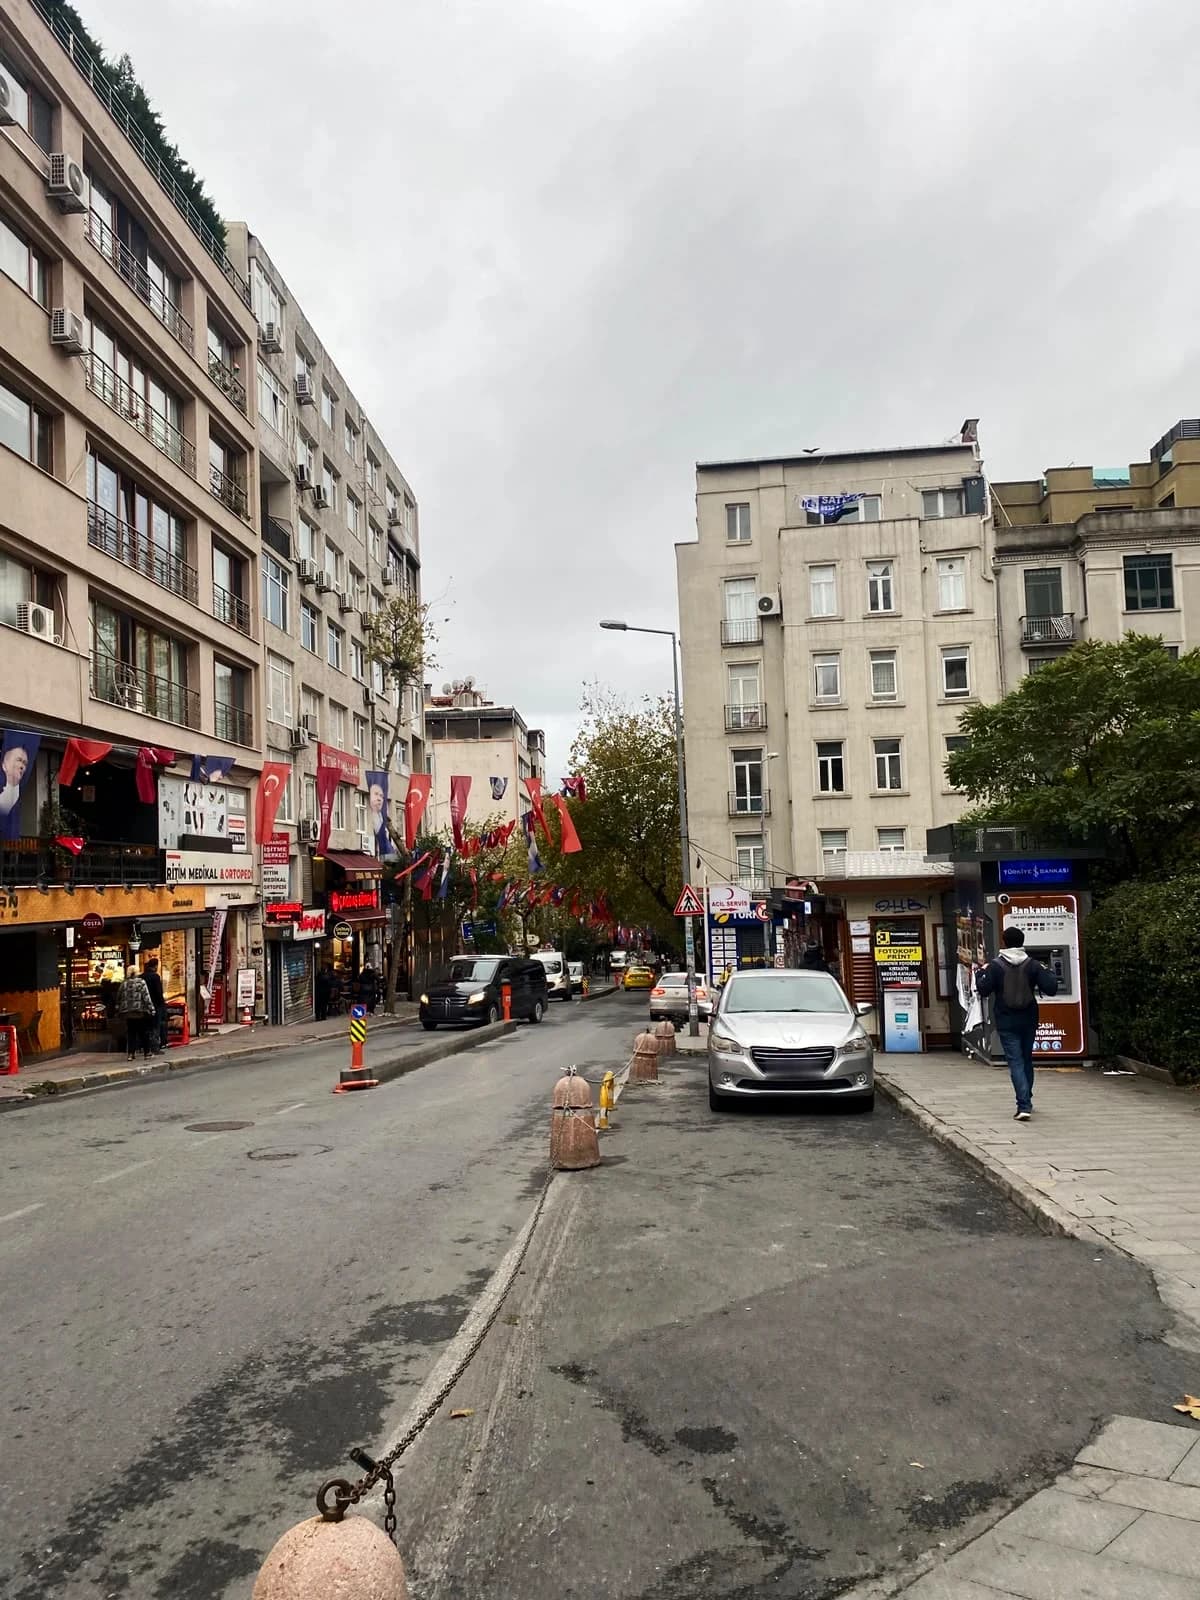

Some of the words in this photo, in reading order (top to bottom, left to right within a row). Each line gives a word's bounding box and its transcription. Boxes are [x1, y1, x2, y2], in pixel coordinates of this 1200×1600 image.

[166, 863, 187, 881] RİTİM
[188, 864, 218, 880] MEDİKAL
[1003, 867, 1032, 875] TÜRKİYE
[1011, 905, 1067, 914] Bankamatik
